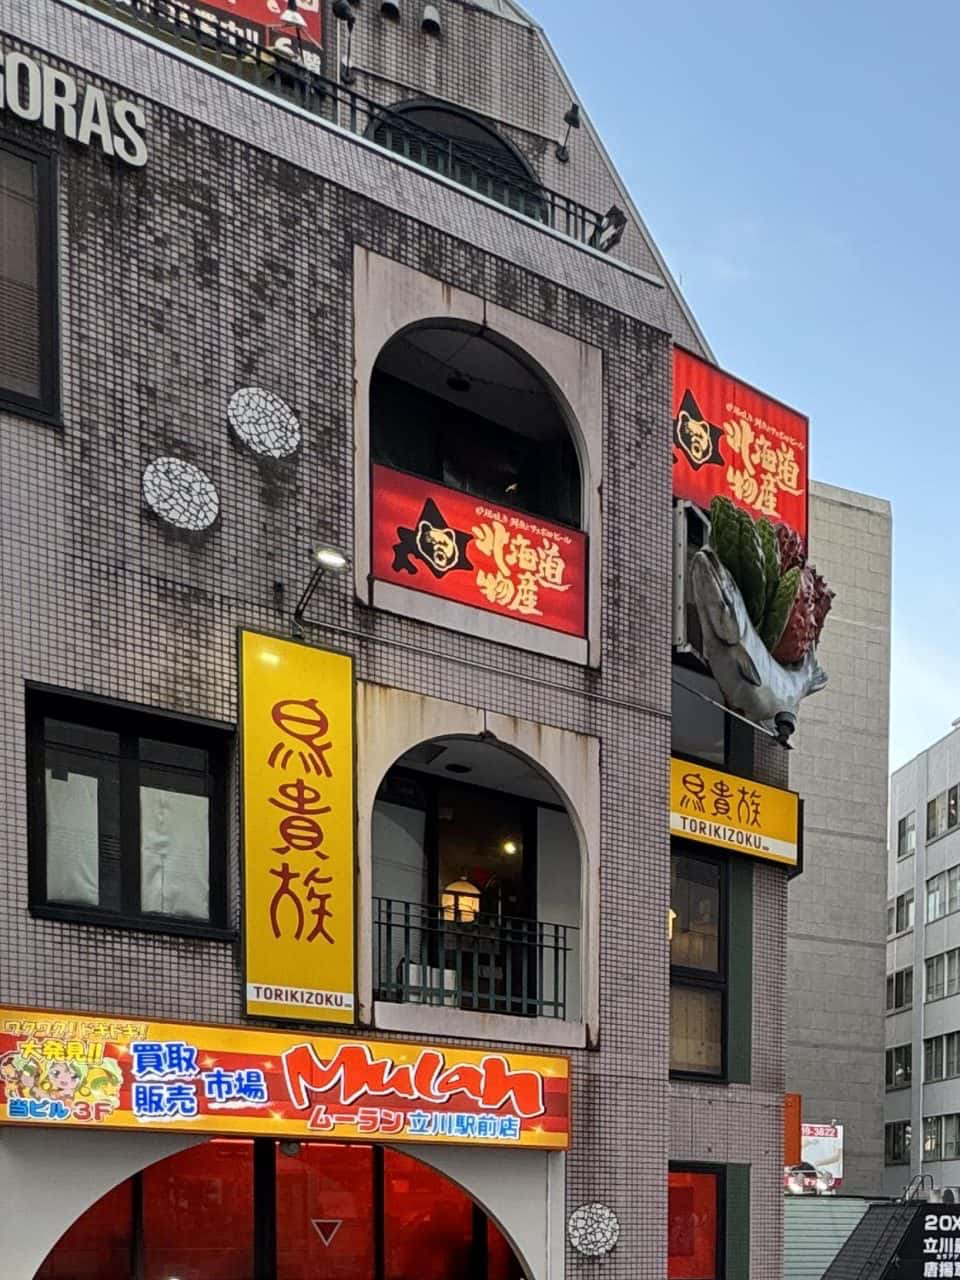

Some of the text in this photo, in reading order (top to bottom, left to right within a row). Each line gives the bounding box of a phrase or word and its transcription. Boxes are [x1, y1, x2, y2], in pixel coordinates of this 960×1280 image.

[0, 52, 148, 168] ORAS
[723, 419, 804, 496] 北海道
[727, 465, 781, 518] 物産
[471, 520, 572, 592] 北海道
[476, 569, 544, 616] 物産
[680, 815, 762, 850] TORIKIZOKU
[253, 985, 344, 1007] TORIKIZOKU
[131, 1041, 199, 1077] 買取
[282, 1043, 545, 1118] Mulan
[133, 1083, 197, 1118] 販売
[203, 1068, 267, 1102] 市場
